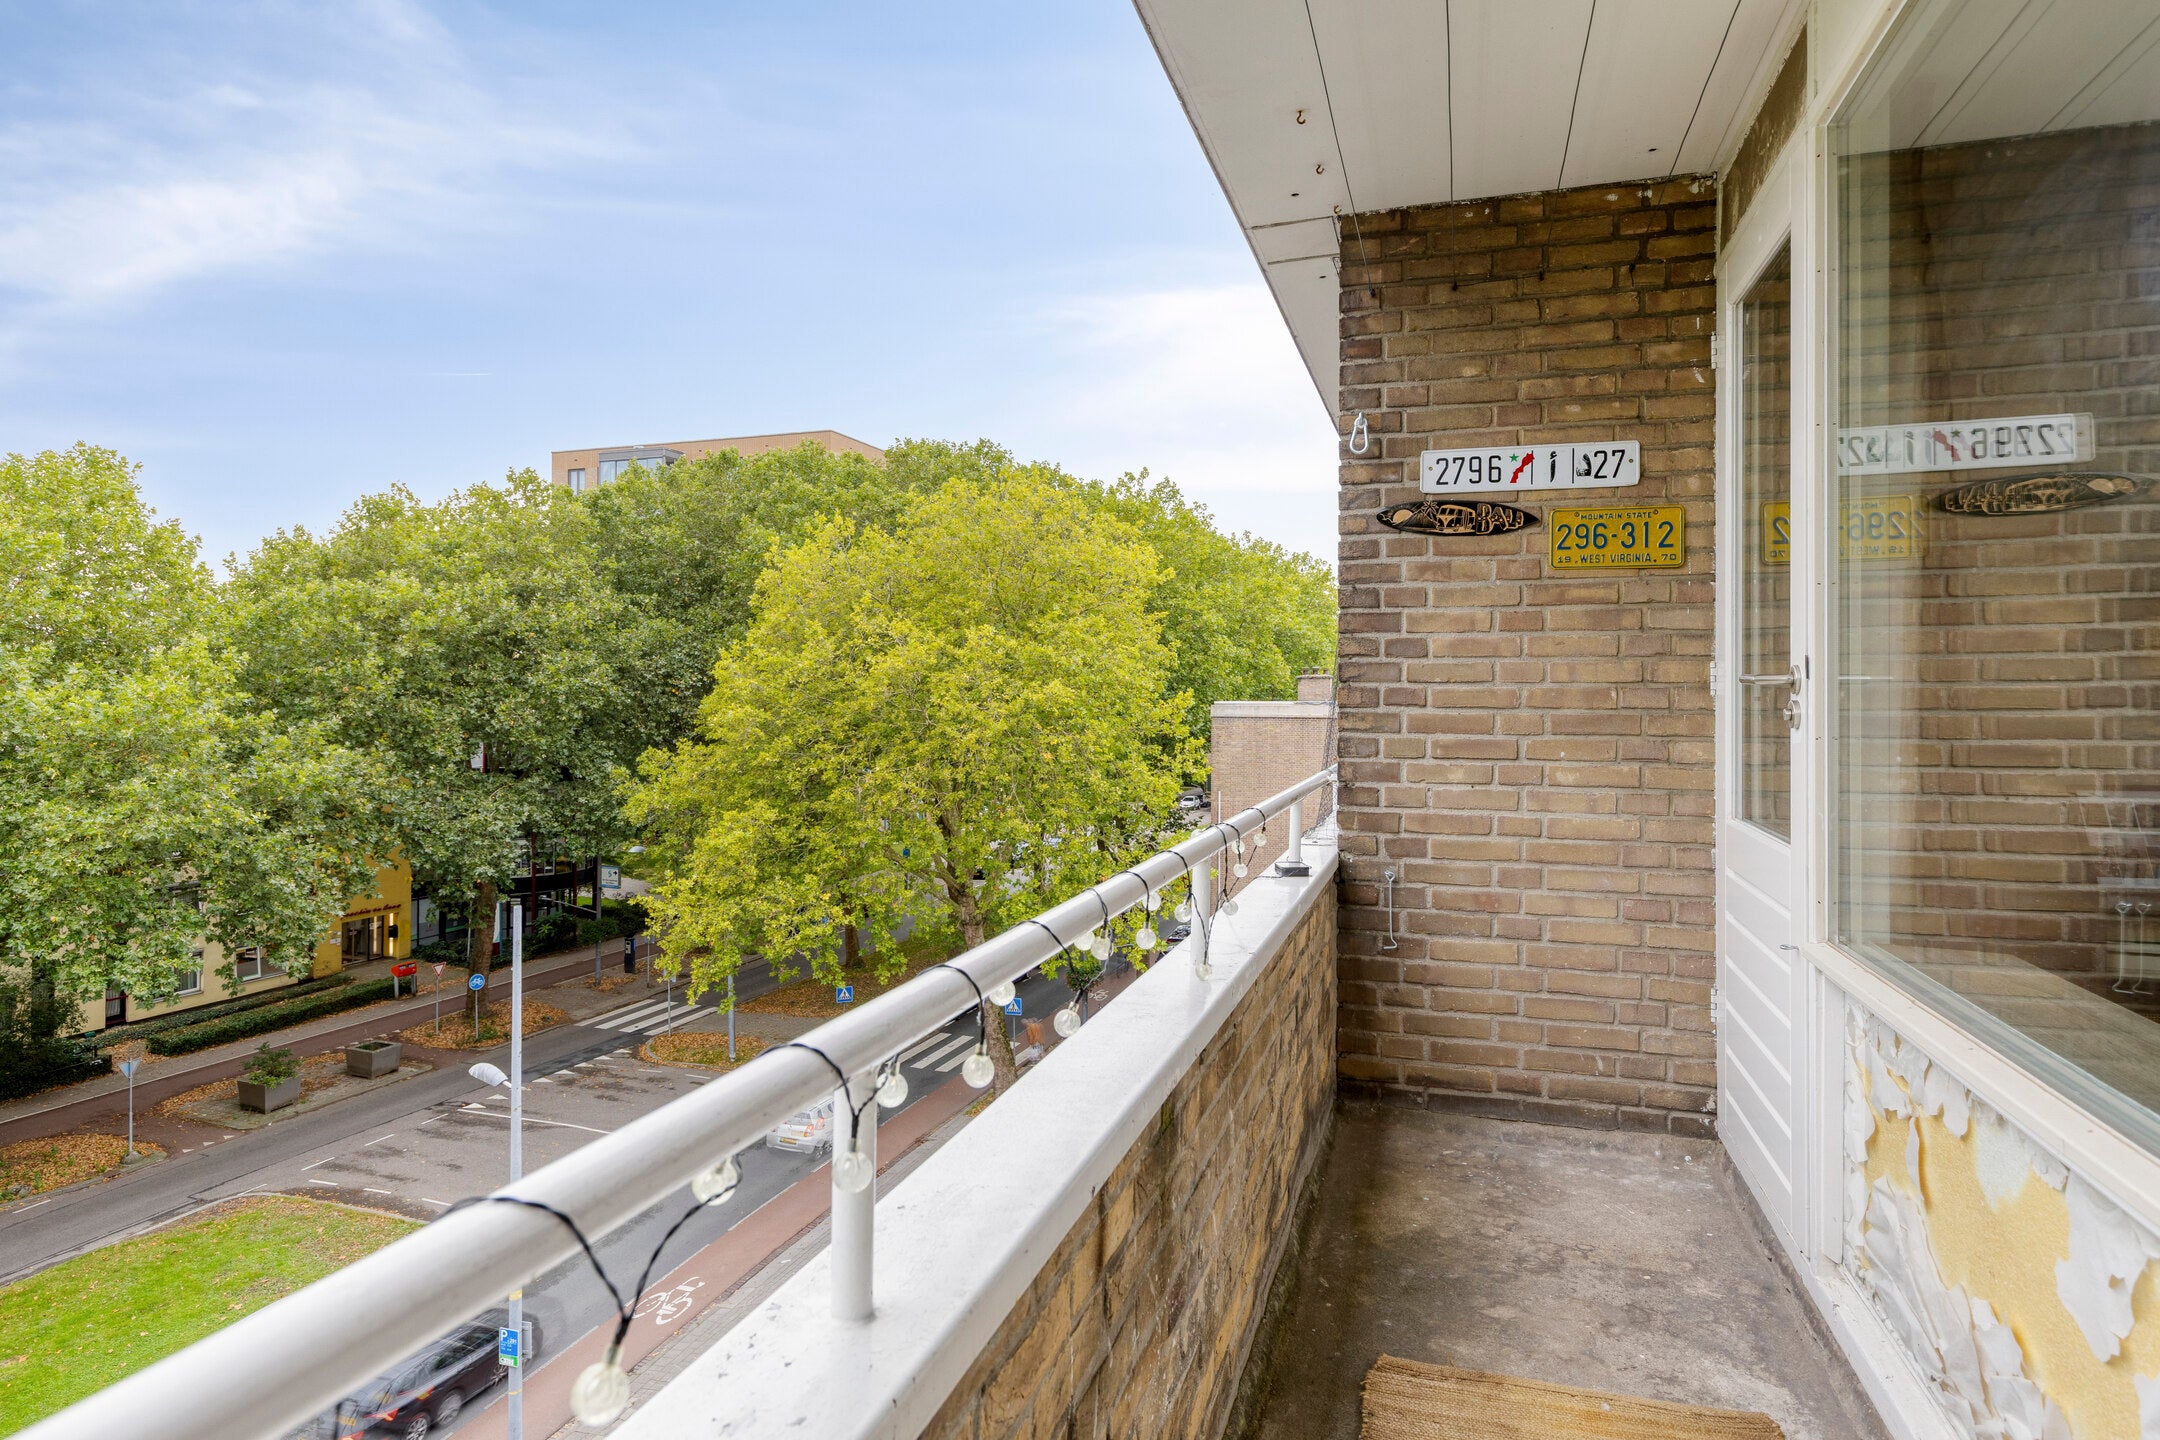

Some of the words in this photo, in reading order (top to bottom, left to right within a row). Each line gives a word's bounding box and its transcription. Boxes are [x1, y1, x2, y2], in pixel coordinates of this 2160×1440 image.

[1435, 454, 1502, 486] 2796
[1593, 449, 1626, 479] 27
[1476, 503, 1524, 534] BALI
[1556, 521, 1674, 550] 296-312
[1557, 556, 1571, 564] 19
[1580, 554, 1605, 564] WEST
[1609, 553, 1652, 563] VIRGINIA
[1660, 553, 1677, 561] 70
